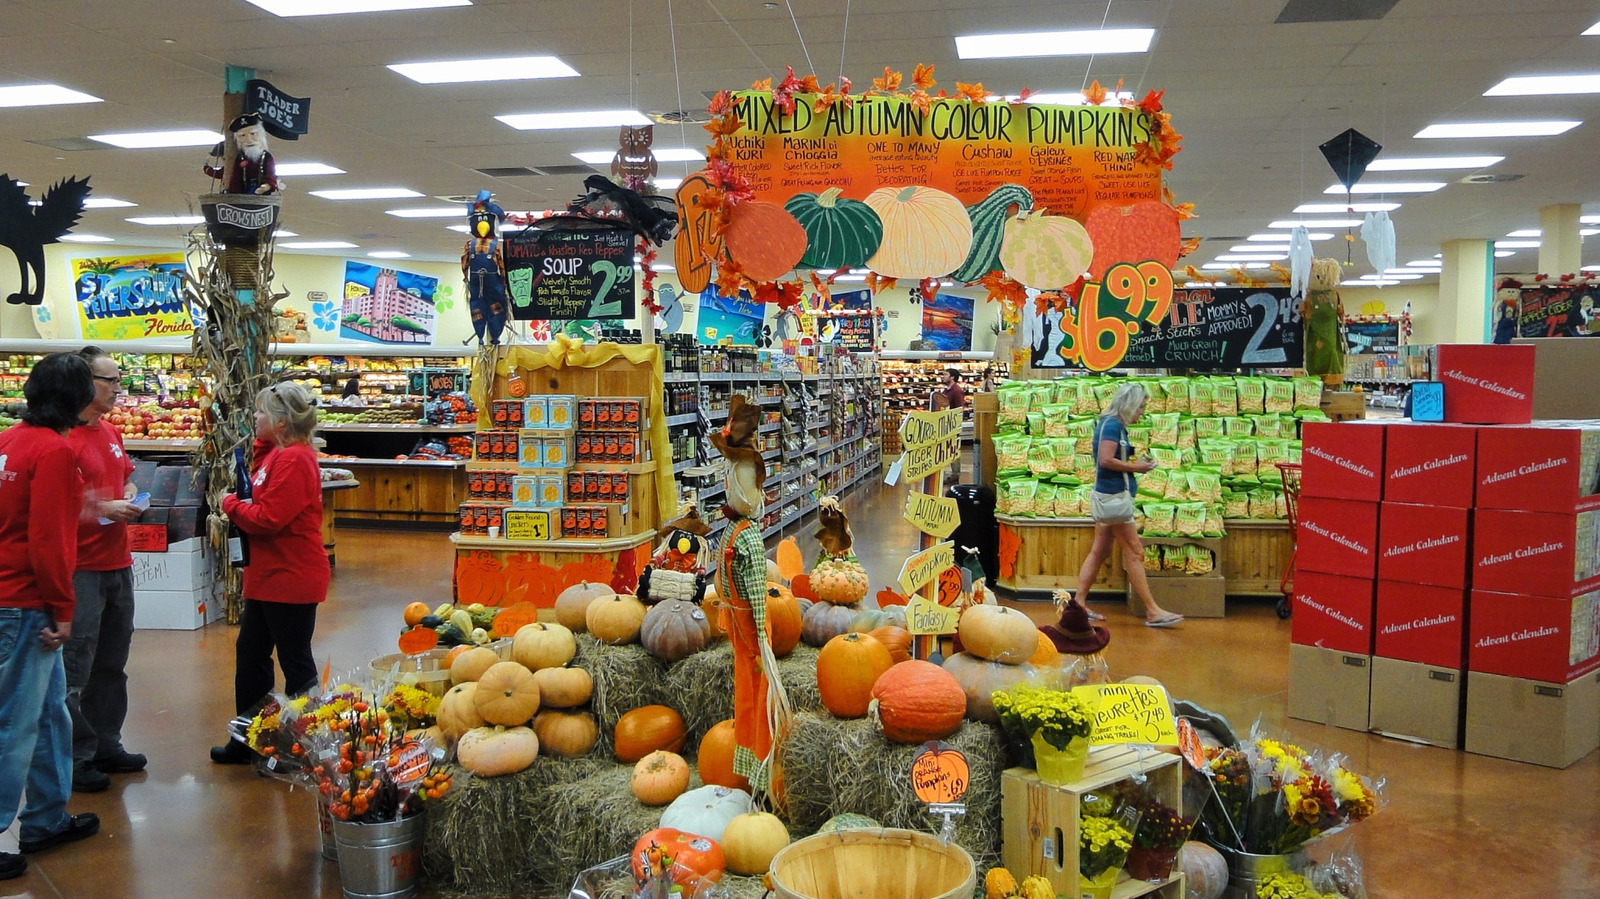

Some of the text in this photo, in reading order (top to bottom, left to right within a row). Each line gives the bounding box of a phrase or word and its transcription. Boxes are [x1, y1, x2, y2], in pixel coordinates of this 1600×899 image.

[257, 86, 300, 115] TRADER
[258, 101, 294, 129] JOE'S
[731, 95, 1151, 148] MIXED AUTUMN COLOUR PUMPKINS
[730, 136, 765, 150] Uchiki
[867, 142, 940, 154] ONE TO MANY
[962, 144, 1013, 160] Cushaw
[1030, 146, 1065, 158] Galeux
[736, 150, 763, 161] KURI
[1094, 151, 1113, 163] RED
[876, 172, 933, 185] DECORATING!
[911, 165, 927, 173] FOR
[1029, 176, 1052, 184] GREAT
[220, 208, 270, 226] CROWS NEST
[542, 257, 583, 276] SOUP
[1207, 302, 1238, 320] MOMMY
[144, 318, 193, 336] Florida
[1166, 327, 1202, 339] Sticks
[1207, 314, 1253, 336] APPROVED!
[1164, 341, 1227, 363] CRUNCH!
[1443, 370, 1525, 400] Advent Calendars
[934, 442, 945, 465] Oh
[1305, 446, 1374, 478] Advent Calendars
[1391, 454, 1468, 479] Advent Calendars
[1483, 457, 1568, 485] Advent Calendars
[914, 498, 954, 523] AUTUMN
[1301, 520, 1369, 555] Advent Calendars
[1384, 534, 1460, 557] Advent Calendars
[133, 554, 150, 573] EW
[1479, 542, 1563, 567] Advent Calendars
[134, 559, 169, 588] ITEM!
[909, 551, 952, 588] Pumpkins
[914, 603, 948, 631] Fantasy
[1297, 594, 1364, 631] Advent Calendars
[1381, 614, 1456, 635] Advent Calendars
[1475, 625, 1559, 648] Advent Calendars
